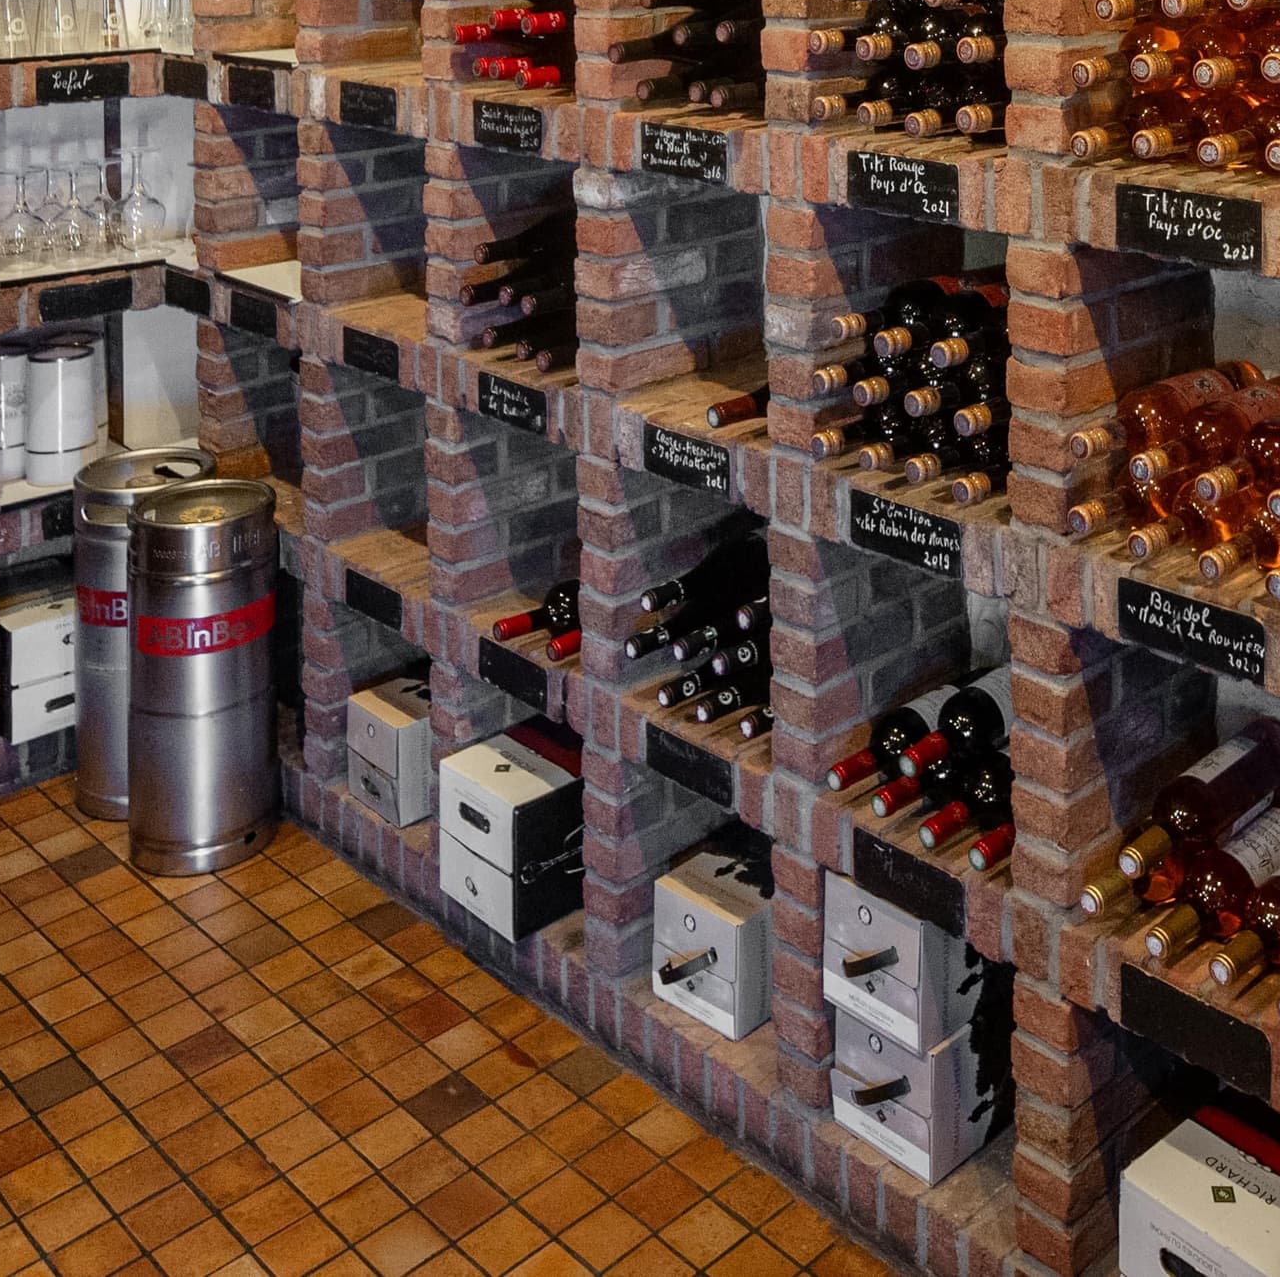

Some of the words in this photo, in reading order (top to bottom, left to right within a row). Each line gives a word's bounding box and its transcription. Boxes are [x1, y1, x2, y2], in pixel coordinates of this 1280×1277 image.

[858, 153, 884, 173] Titi
[888, 157, 925, 181] Rouge
[870, 175, 895, 194] Pays
[921, 198, 949, 217] 2021
[1141, 191, 1175, 219] Titi
[1182, 199, 1222, 222] Rosé
[1148, 213, 1179, 240] Pays
[1223, 242, 1254, 259] 2021
[1204, 1155, 1278, 1206] RICHARD
